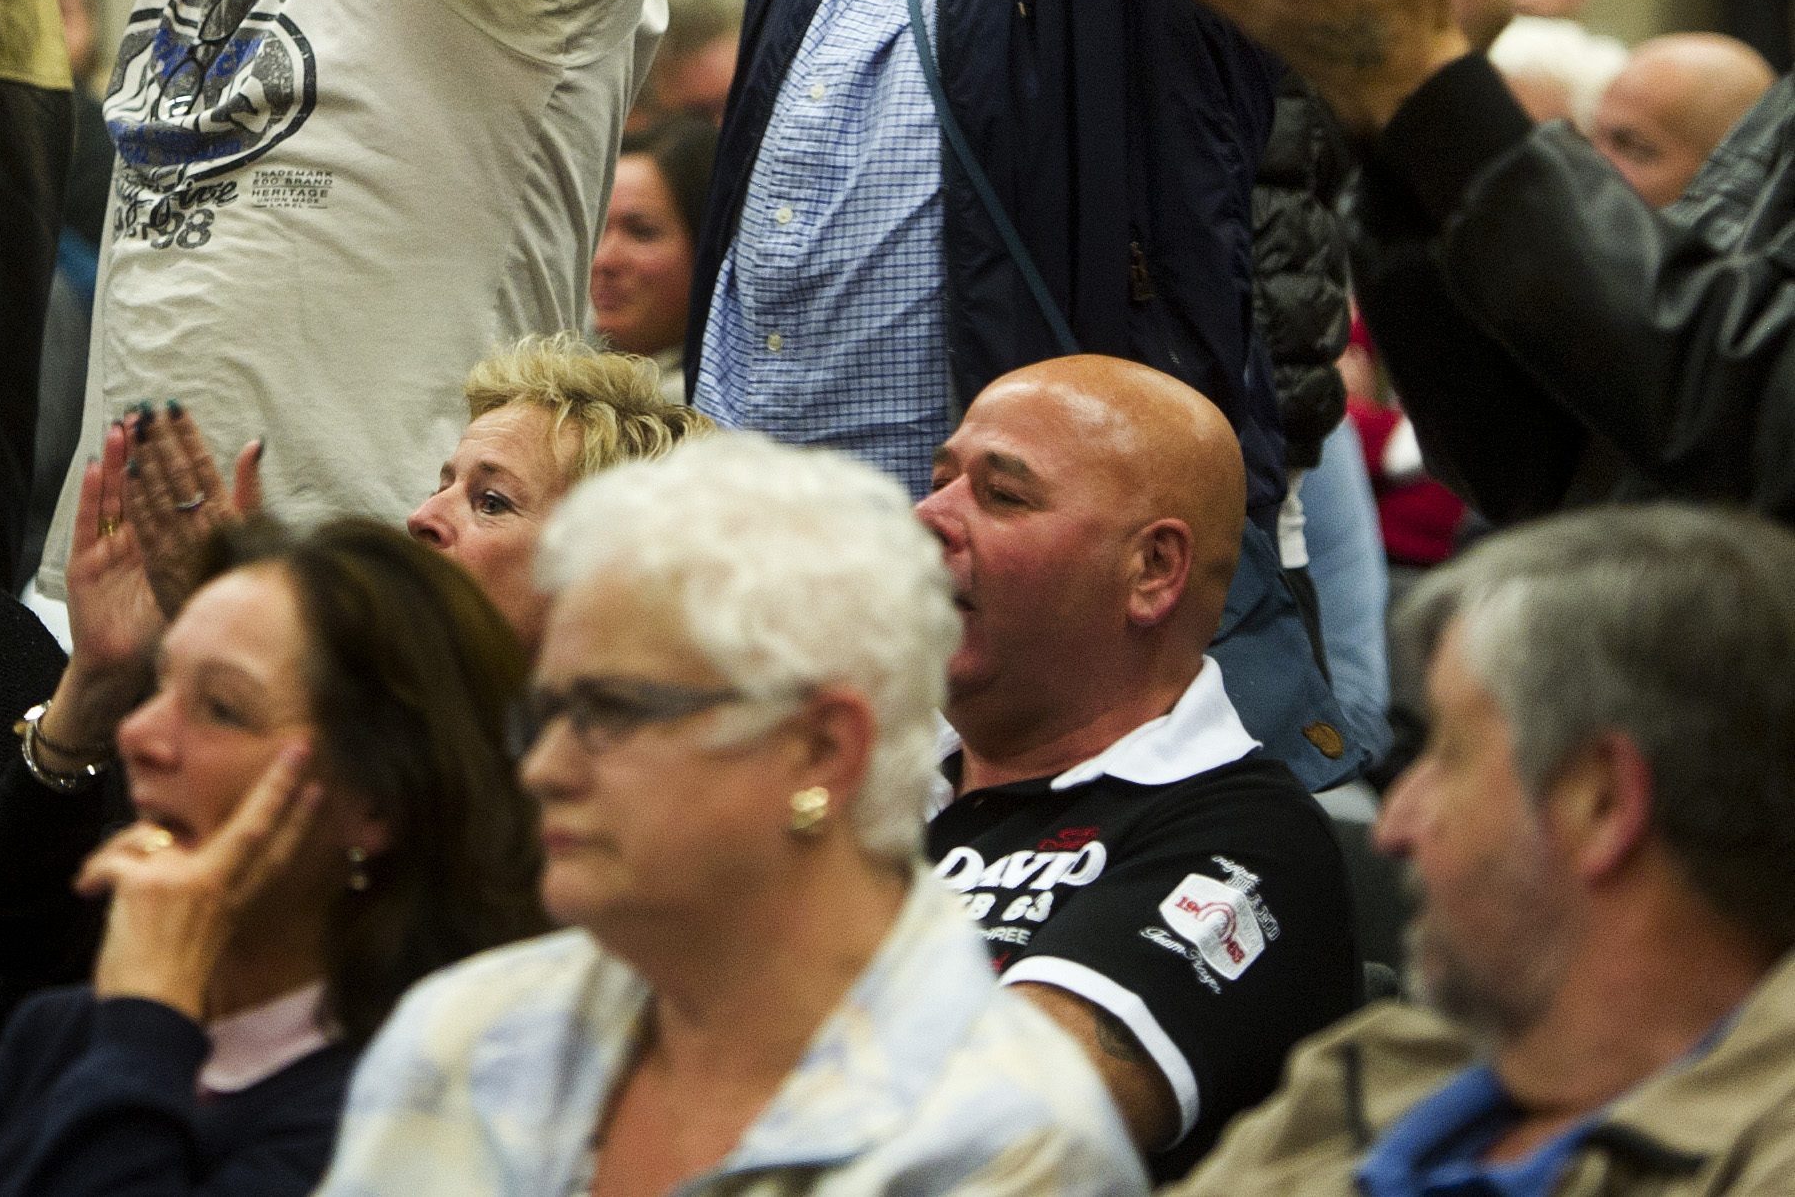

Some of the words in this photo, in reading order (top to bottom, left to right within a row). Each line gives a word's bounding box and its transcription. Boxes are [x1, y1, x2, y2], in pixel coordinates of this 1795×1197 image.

[254, 169, 333, 178] TRADEMARK
[284, 178, 333, 186] BRAND
[251, 189, 329, 198] HERITAGE
[932, 840, 1107, 894] DAVID
[1000, 890, 1055, 923] 63
[1175, 896, 1201, 914] 19
[1139, 925, 1187, 957] Team
[1226, 940, 1246, 965] 63
